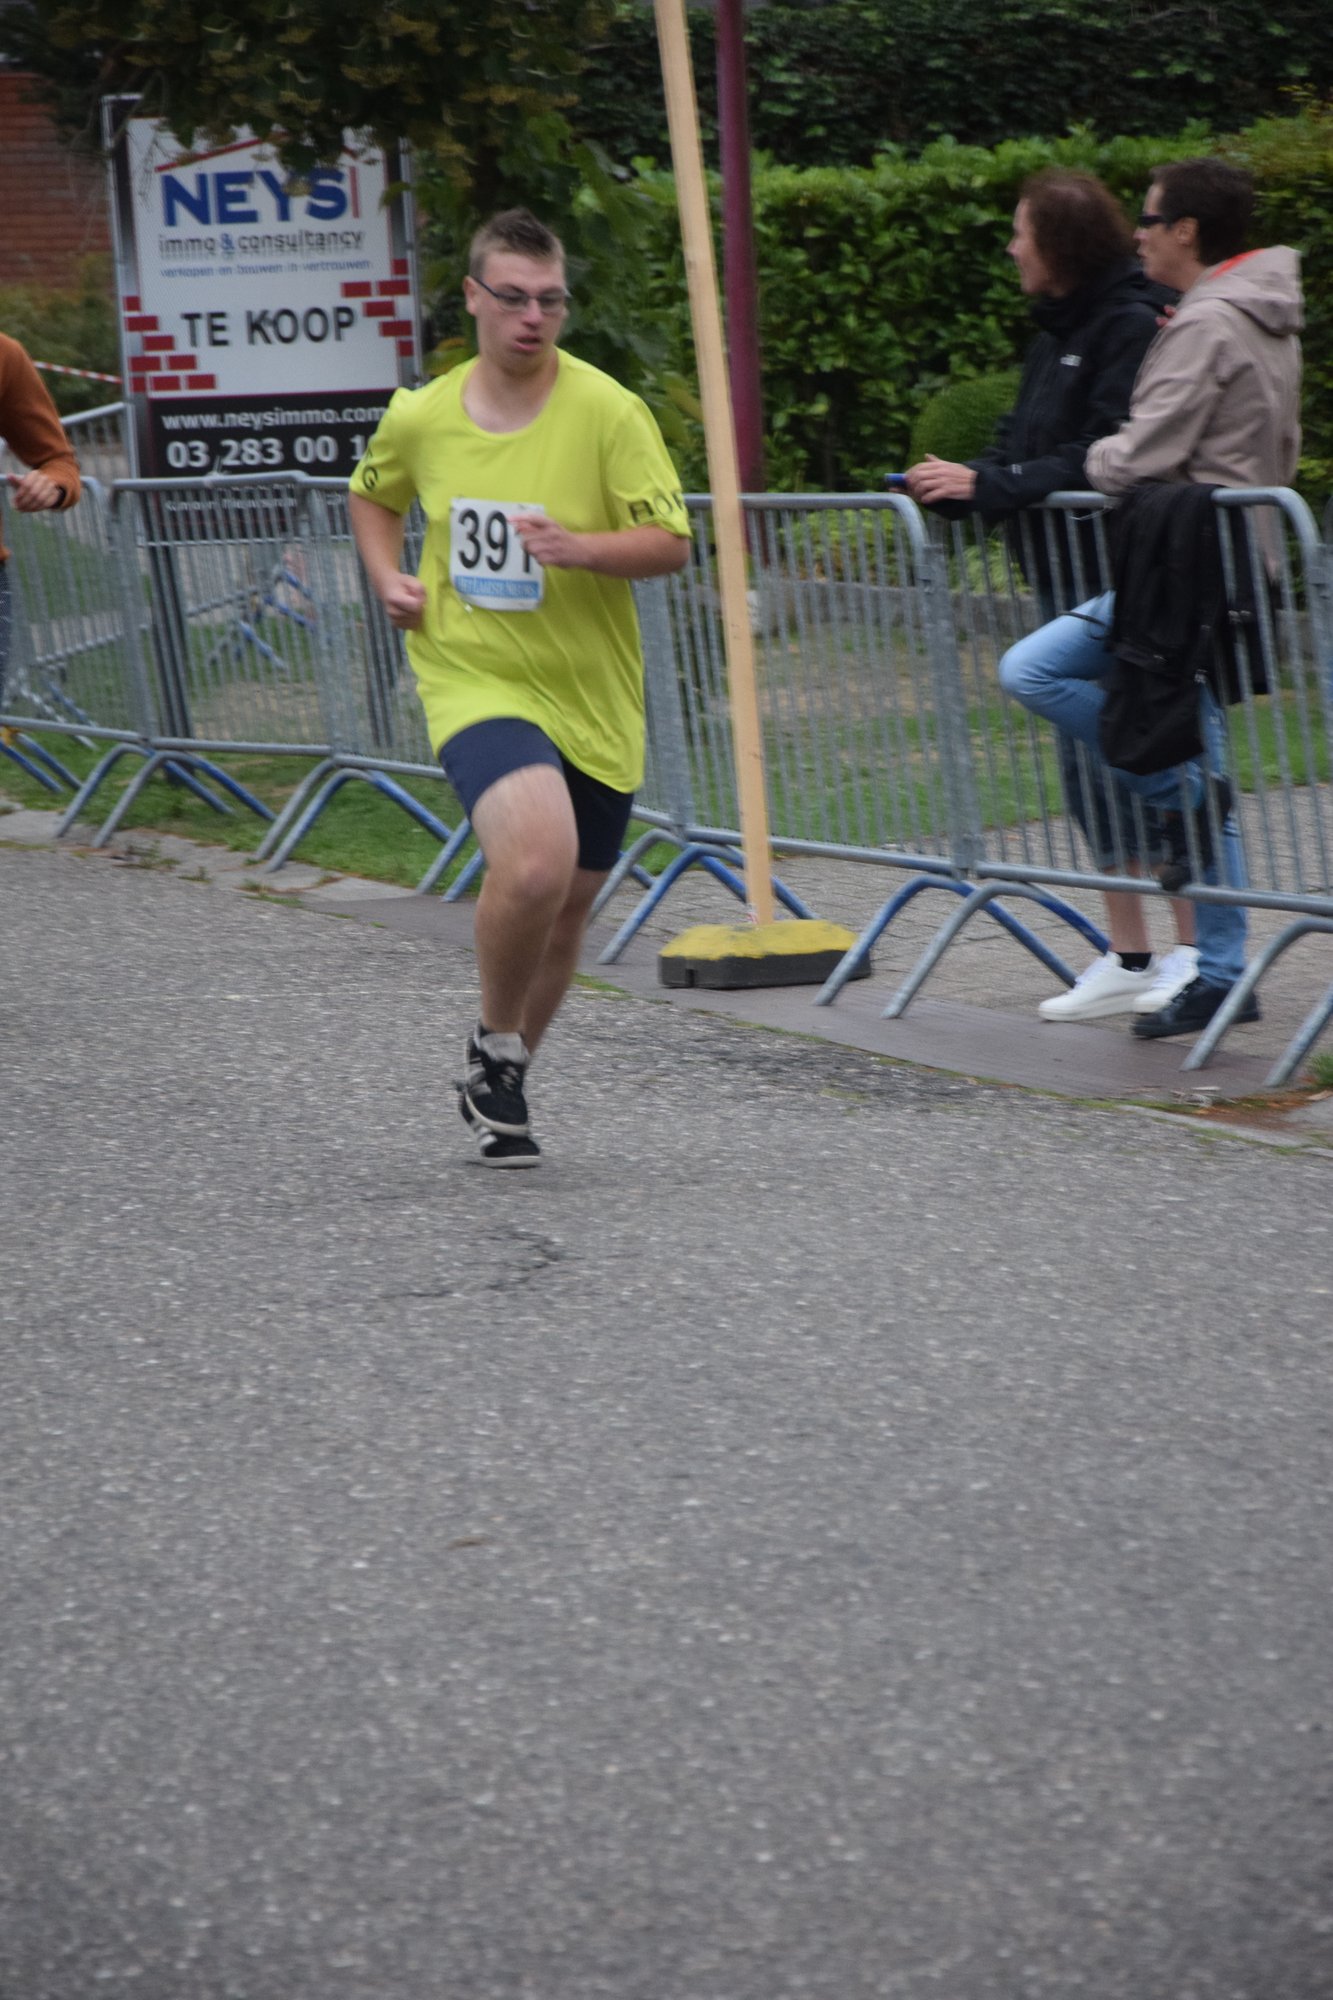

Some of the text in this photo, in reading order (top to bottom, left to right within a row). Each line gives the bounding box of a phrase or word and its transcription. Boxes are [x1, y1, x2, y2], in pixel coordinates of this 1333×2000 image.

[160, 168, 349, 227] NEYS
[159, 229, 364, 251] immo & consultancy
[181, 306, 356, 347] TE KOOP
[166, 440, 210, 468] 03
[220, 437, 283, 466] 283
[294, 435, 338, 463] 00
